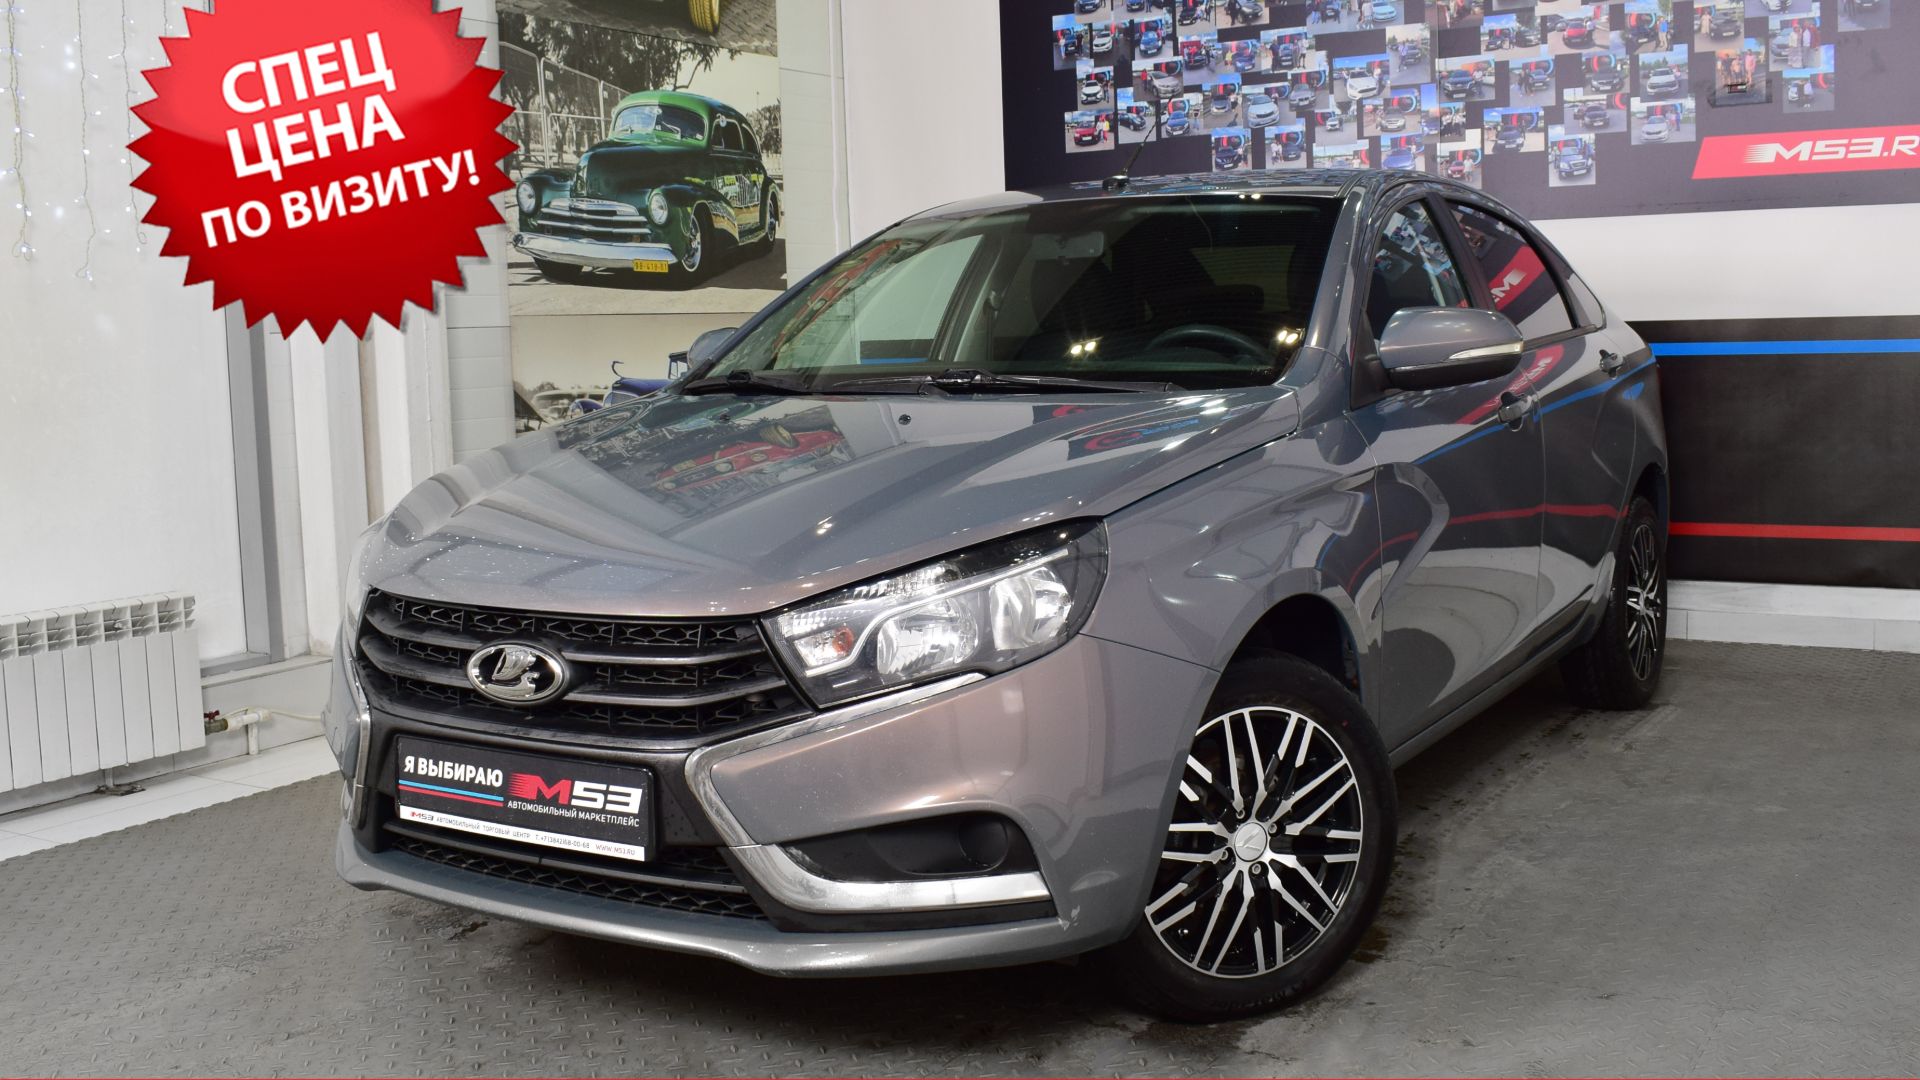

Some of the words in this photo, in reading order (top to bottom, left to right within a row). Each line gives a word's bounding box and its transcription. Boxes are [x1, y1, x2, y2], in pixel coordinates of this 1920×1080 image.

[403, 755, 415, 774] Я
[417, 757, 503, 788] ВЫБИРАЮ
[508, 772, 643, 814] M53
[436, 817, 480, 830] АВТОМОБИЛЬНЫЙ
[507, 800, 577, 819] АВТОМОБИЛЬНЫЙ
[578, 811, 640, 828] МАРКЕТПЛЕЙС
